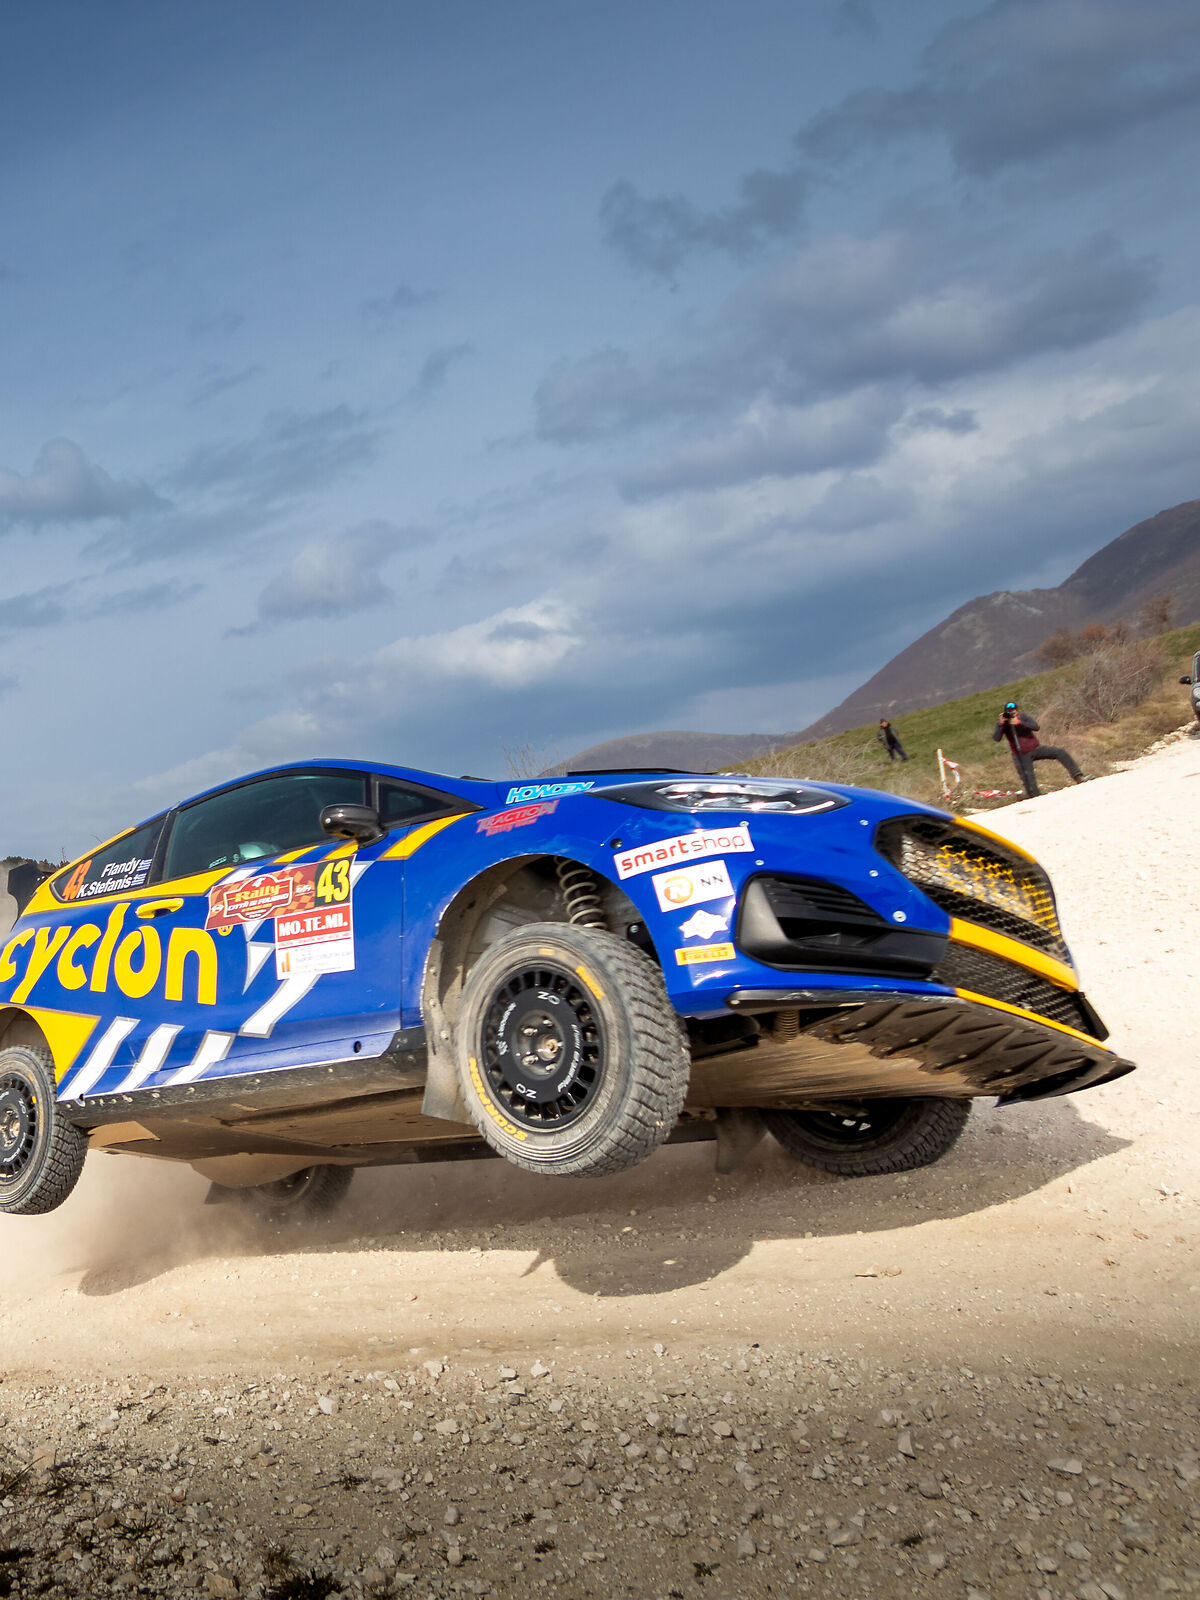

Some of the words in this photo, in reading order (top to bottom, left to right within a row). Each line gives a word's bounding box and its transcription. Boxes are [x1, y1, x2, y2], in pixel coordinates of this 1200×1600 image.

[506, 781, 595, 805] HOWDEN
[101, 857, 141, 878] Flandy
[62, 859, 92, 901] 43
[76, 875, 133, 899] K.Stefanis
[317, 859, 350, 904] 43
[700, 874, 724, 887] NN
[234, 885, 280, 903] Rally
[278, 912, 349, 937] MO.TE.MI.
[468, 1057, 528, 1142] SCORPION
[516, 1083, 537, 1099] OZ
